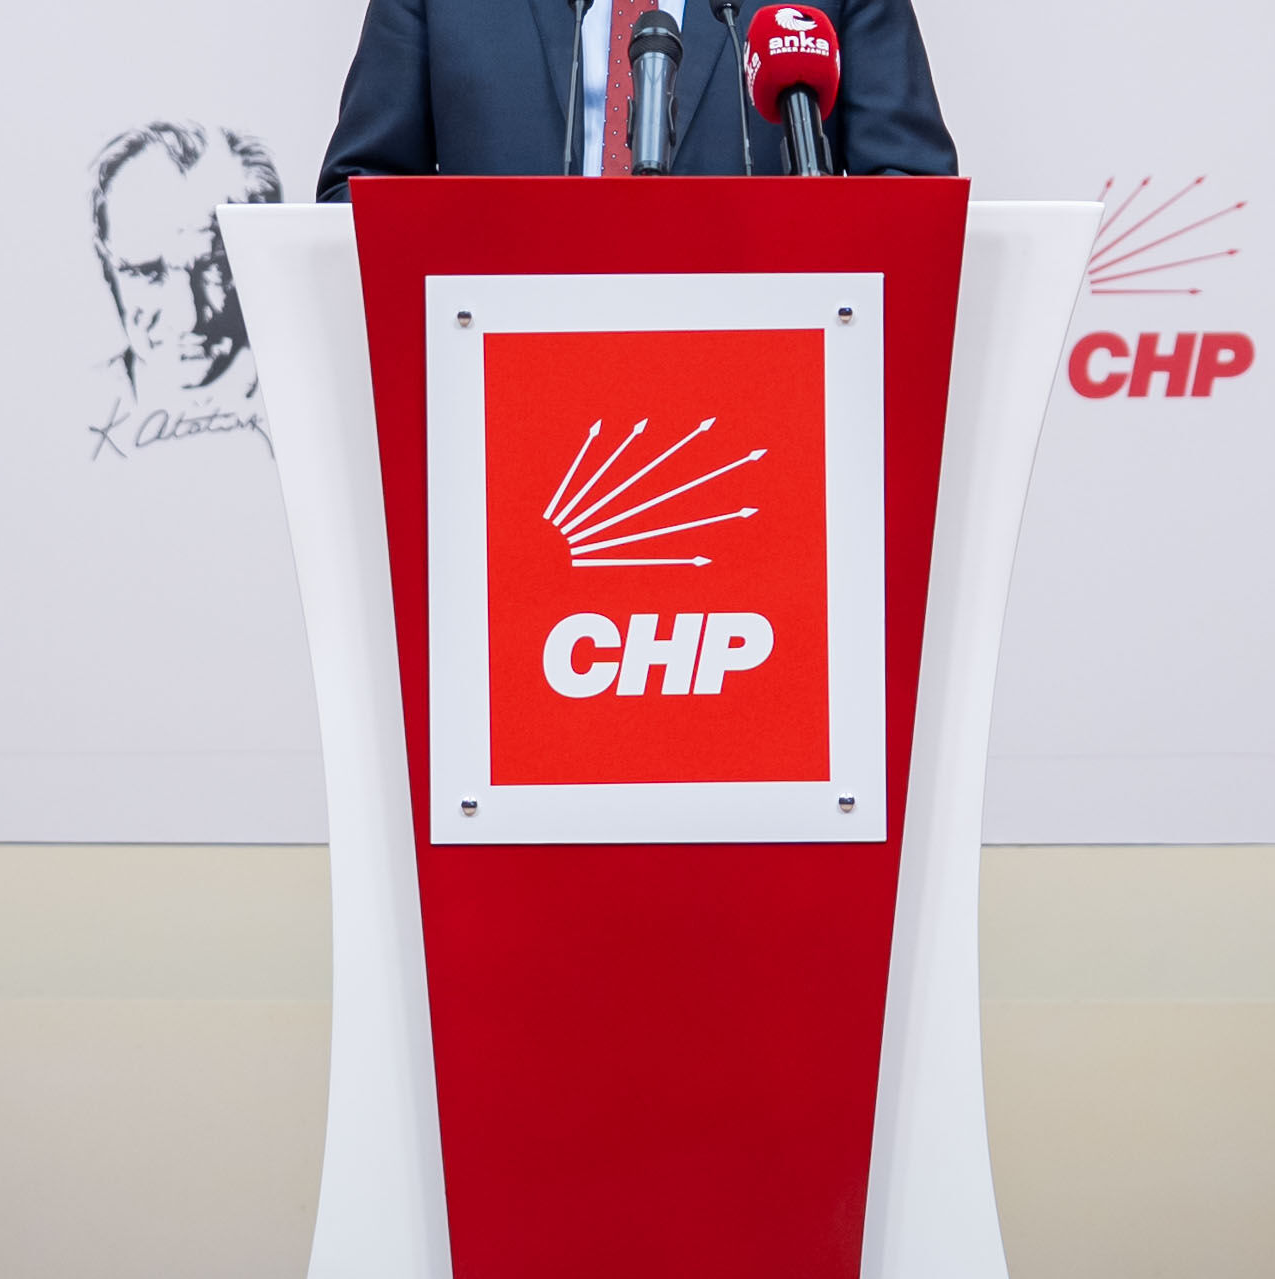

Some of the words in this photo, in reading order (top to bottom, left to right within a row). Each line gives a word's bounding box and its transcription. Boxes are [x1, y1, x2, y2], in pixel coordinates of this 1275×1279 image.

[768, 31, 829, 51] anka
[1067, 330, 1256, 400] CHP
[542, 612, 774, 698] CHP
